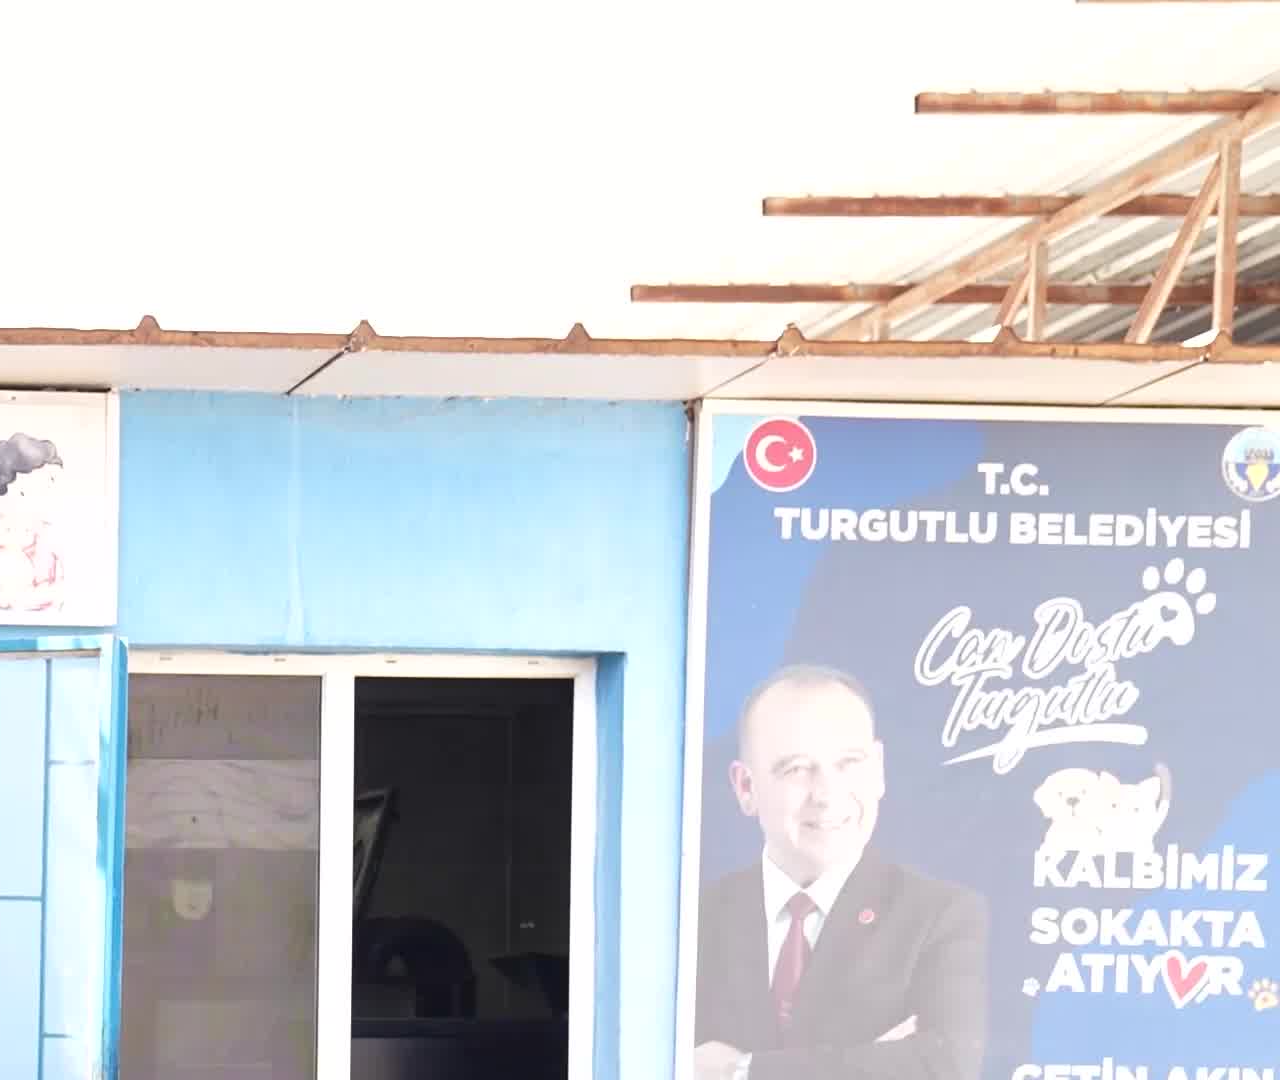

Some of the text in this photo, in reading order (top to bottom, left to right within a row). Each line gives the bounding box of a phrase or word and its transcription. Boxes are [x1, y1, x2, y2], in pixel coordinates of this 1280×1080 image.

[977, 464, 1049, 496] T.C.
[774, 506, 1250, 549] TURGUTLU BELEDİYESİ
[914, 596, 1162, 686] Can Dostu
[1032, 843, 1268, 891] KALBİMİZ
[1029, 907, 1266, 949] SOKAKTA
